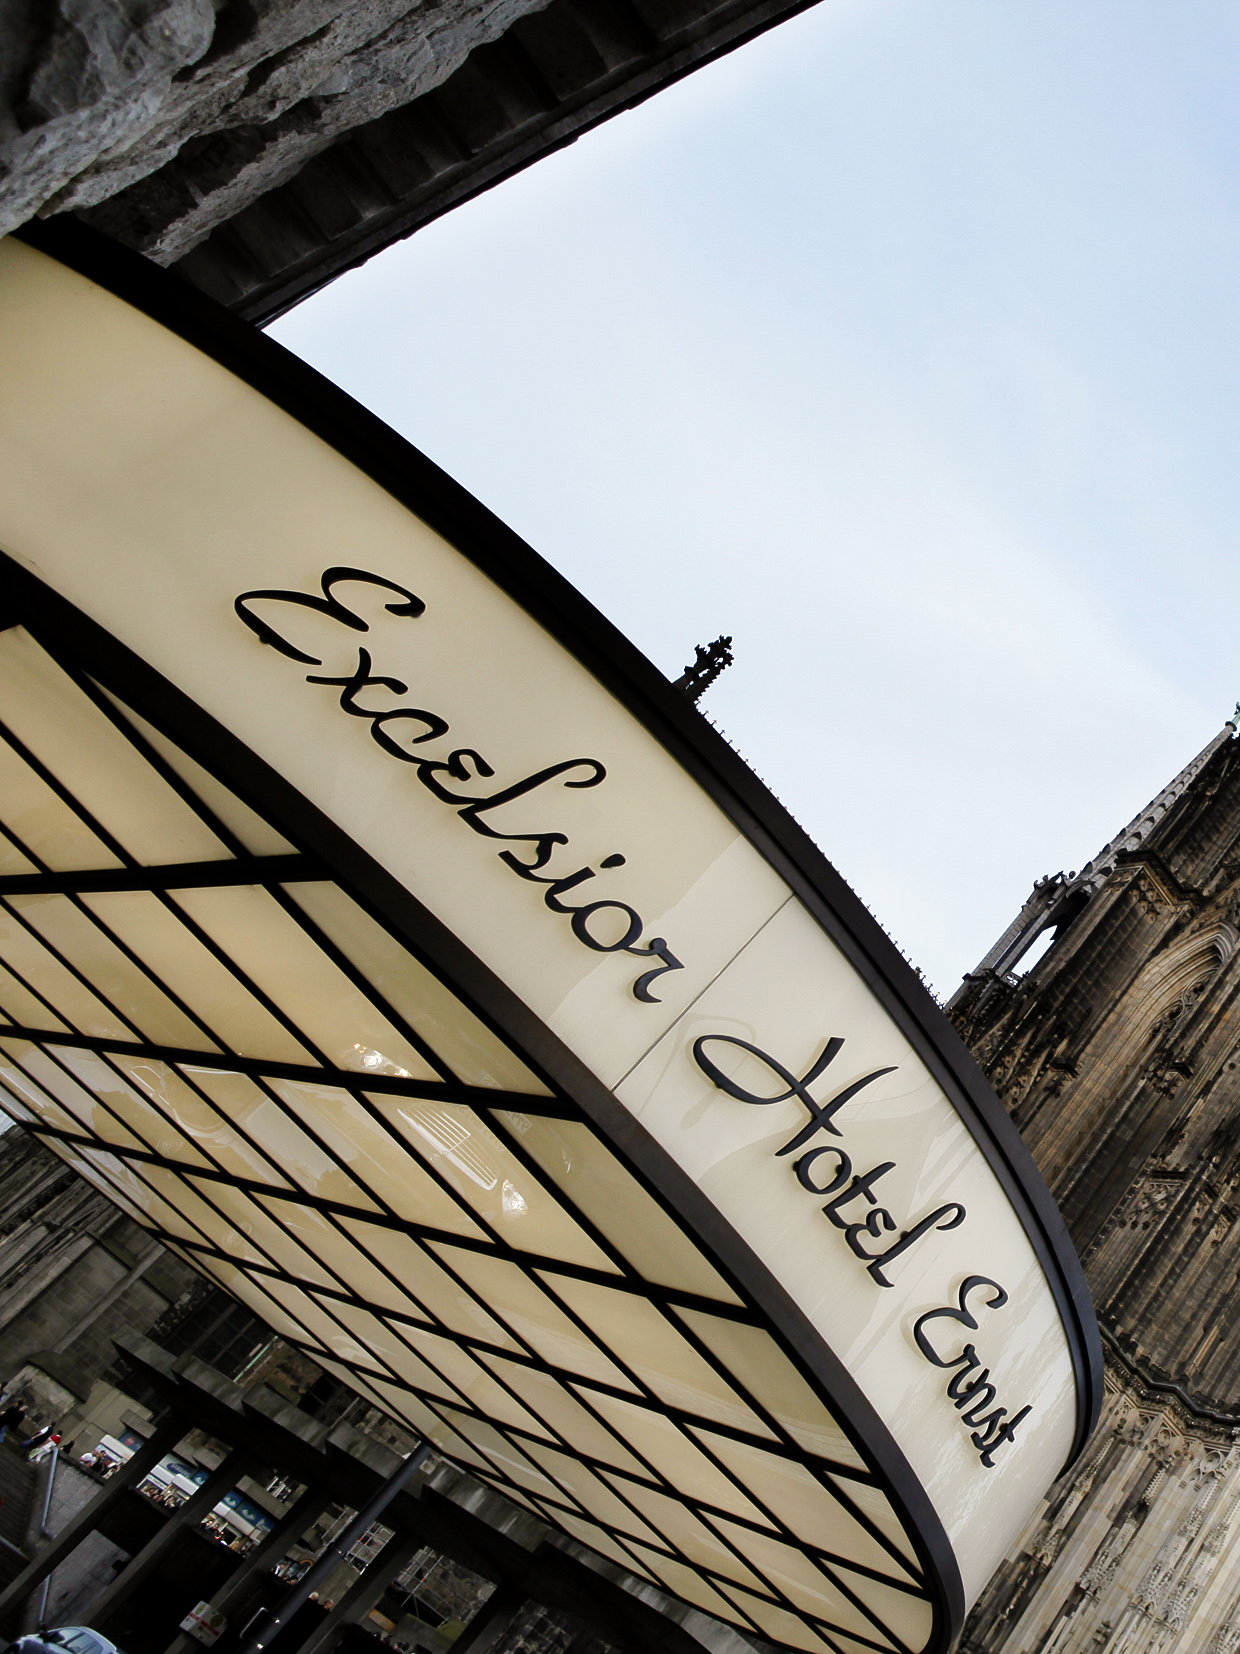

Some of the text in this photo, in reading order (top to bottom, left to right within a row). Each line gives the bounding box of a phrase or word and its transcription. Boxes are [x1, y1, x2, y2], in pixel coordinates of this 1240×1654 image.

[235, 566, 1034, 1468] Excelsior Hotel Ernst
[171, 1463, 191, 1479] SAMSUNG
